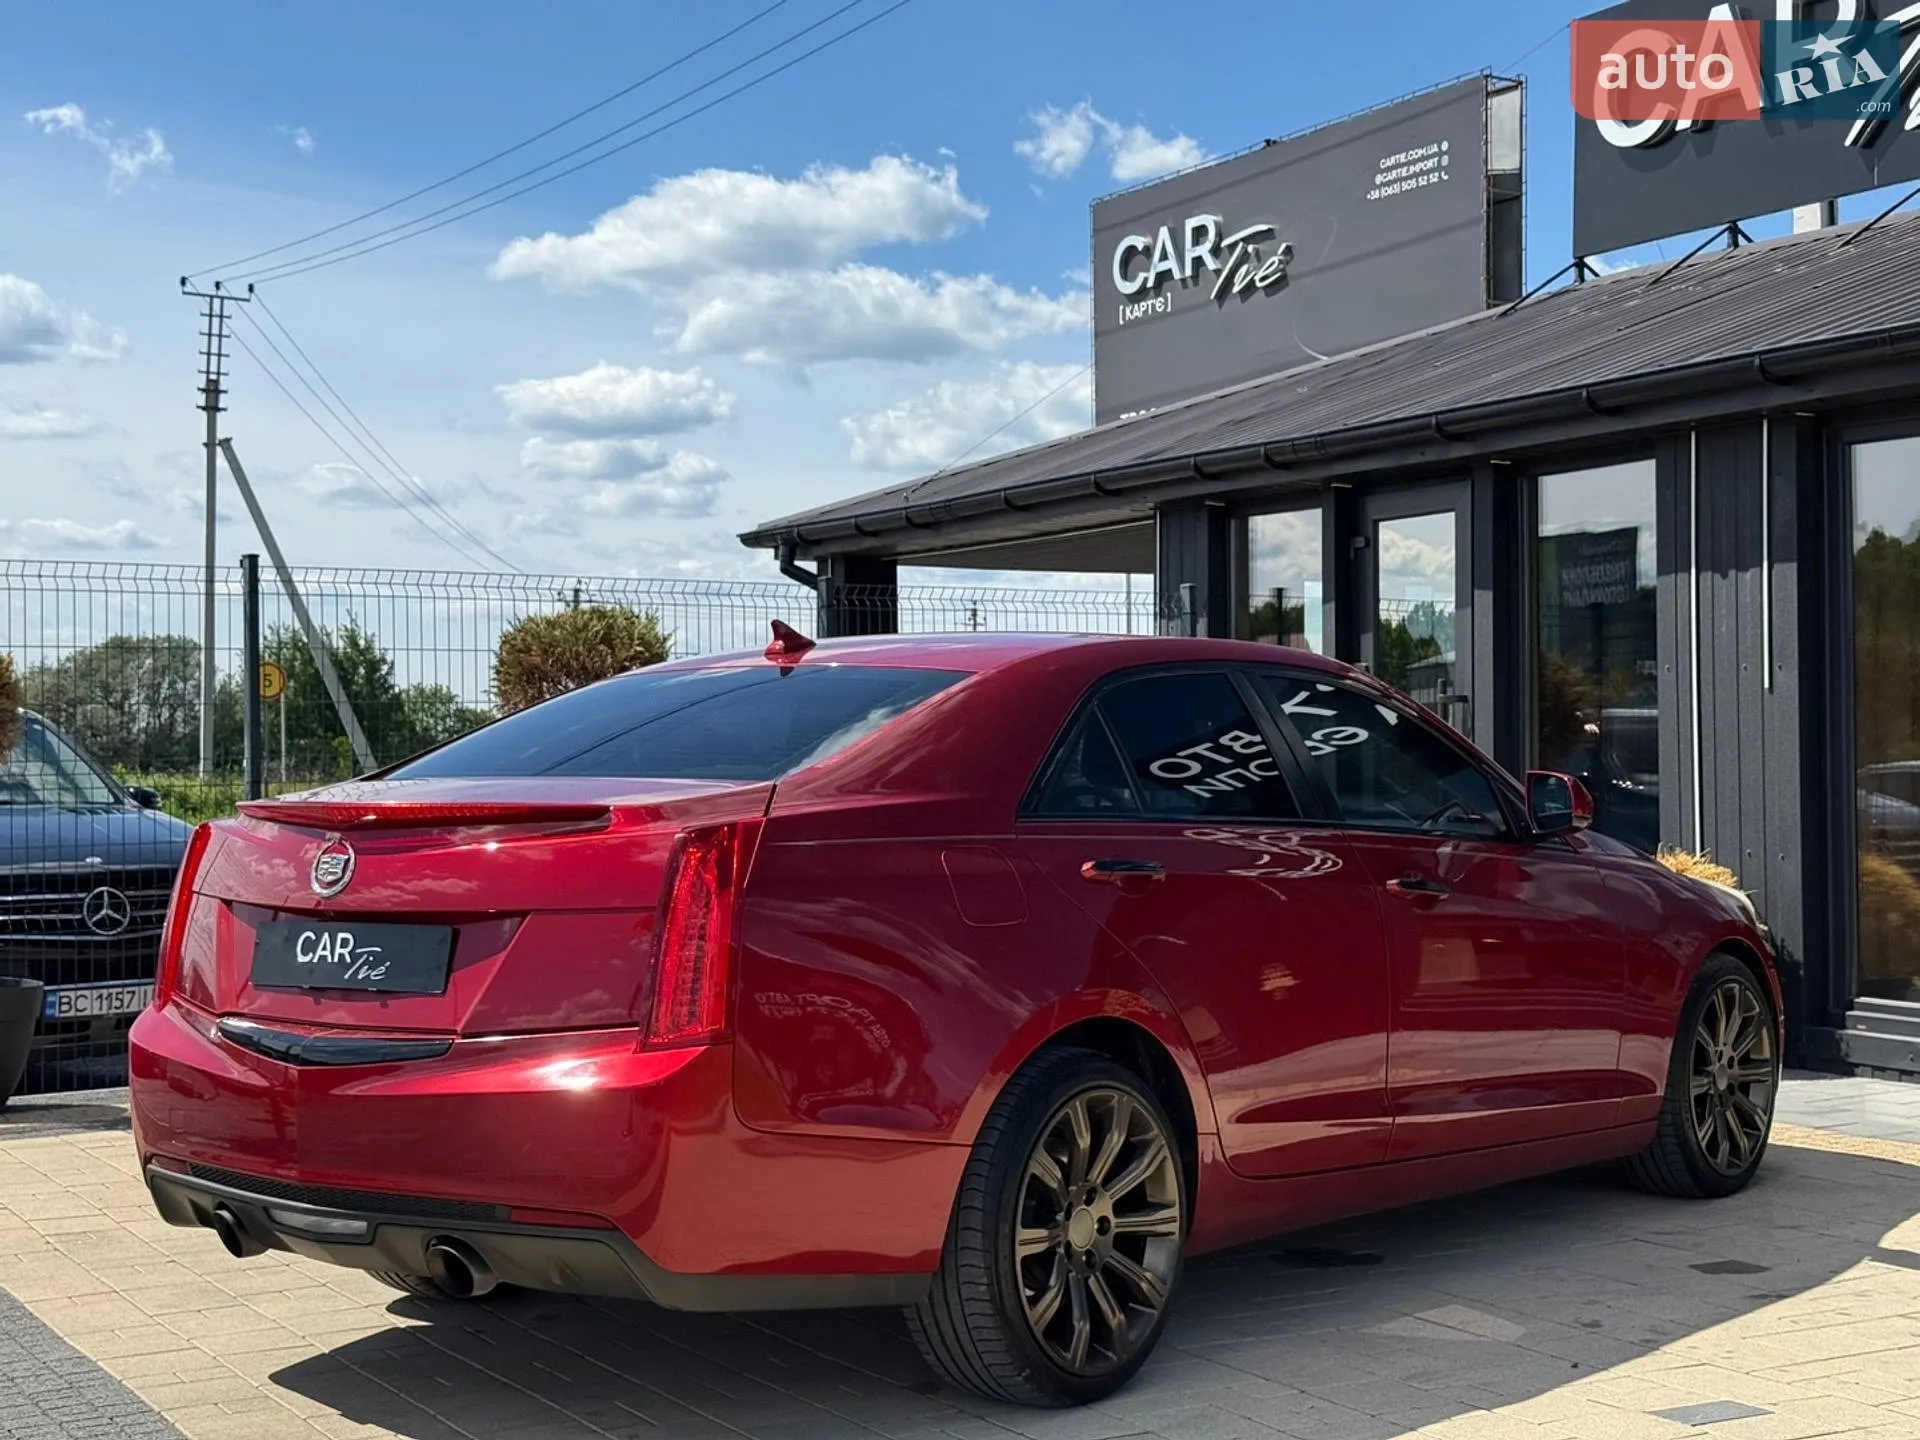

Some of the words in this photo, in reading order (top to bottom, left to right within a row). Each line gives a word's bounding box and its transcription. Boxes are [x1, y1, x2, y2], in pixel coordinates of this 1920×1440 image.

[1593, 0, 1858, 148] CAR
[1379, 143, 1440, 169] CARTIE.COM.UA
[1366, 189, 1380, 200] +38
[1401, 178, 1417, 192] 505
[1418, 175, 1428, 187] 52
[1429, 171, 1440, 184] 52
[1112, 213, 1223, 295] CAR
[296, 930, 355, 963] CAR
[58, 995, 88, 1014] BC
[95, 990, 137, 1011] 1157
